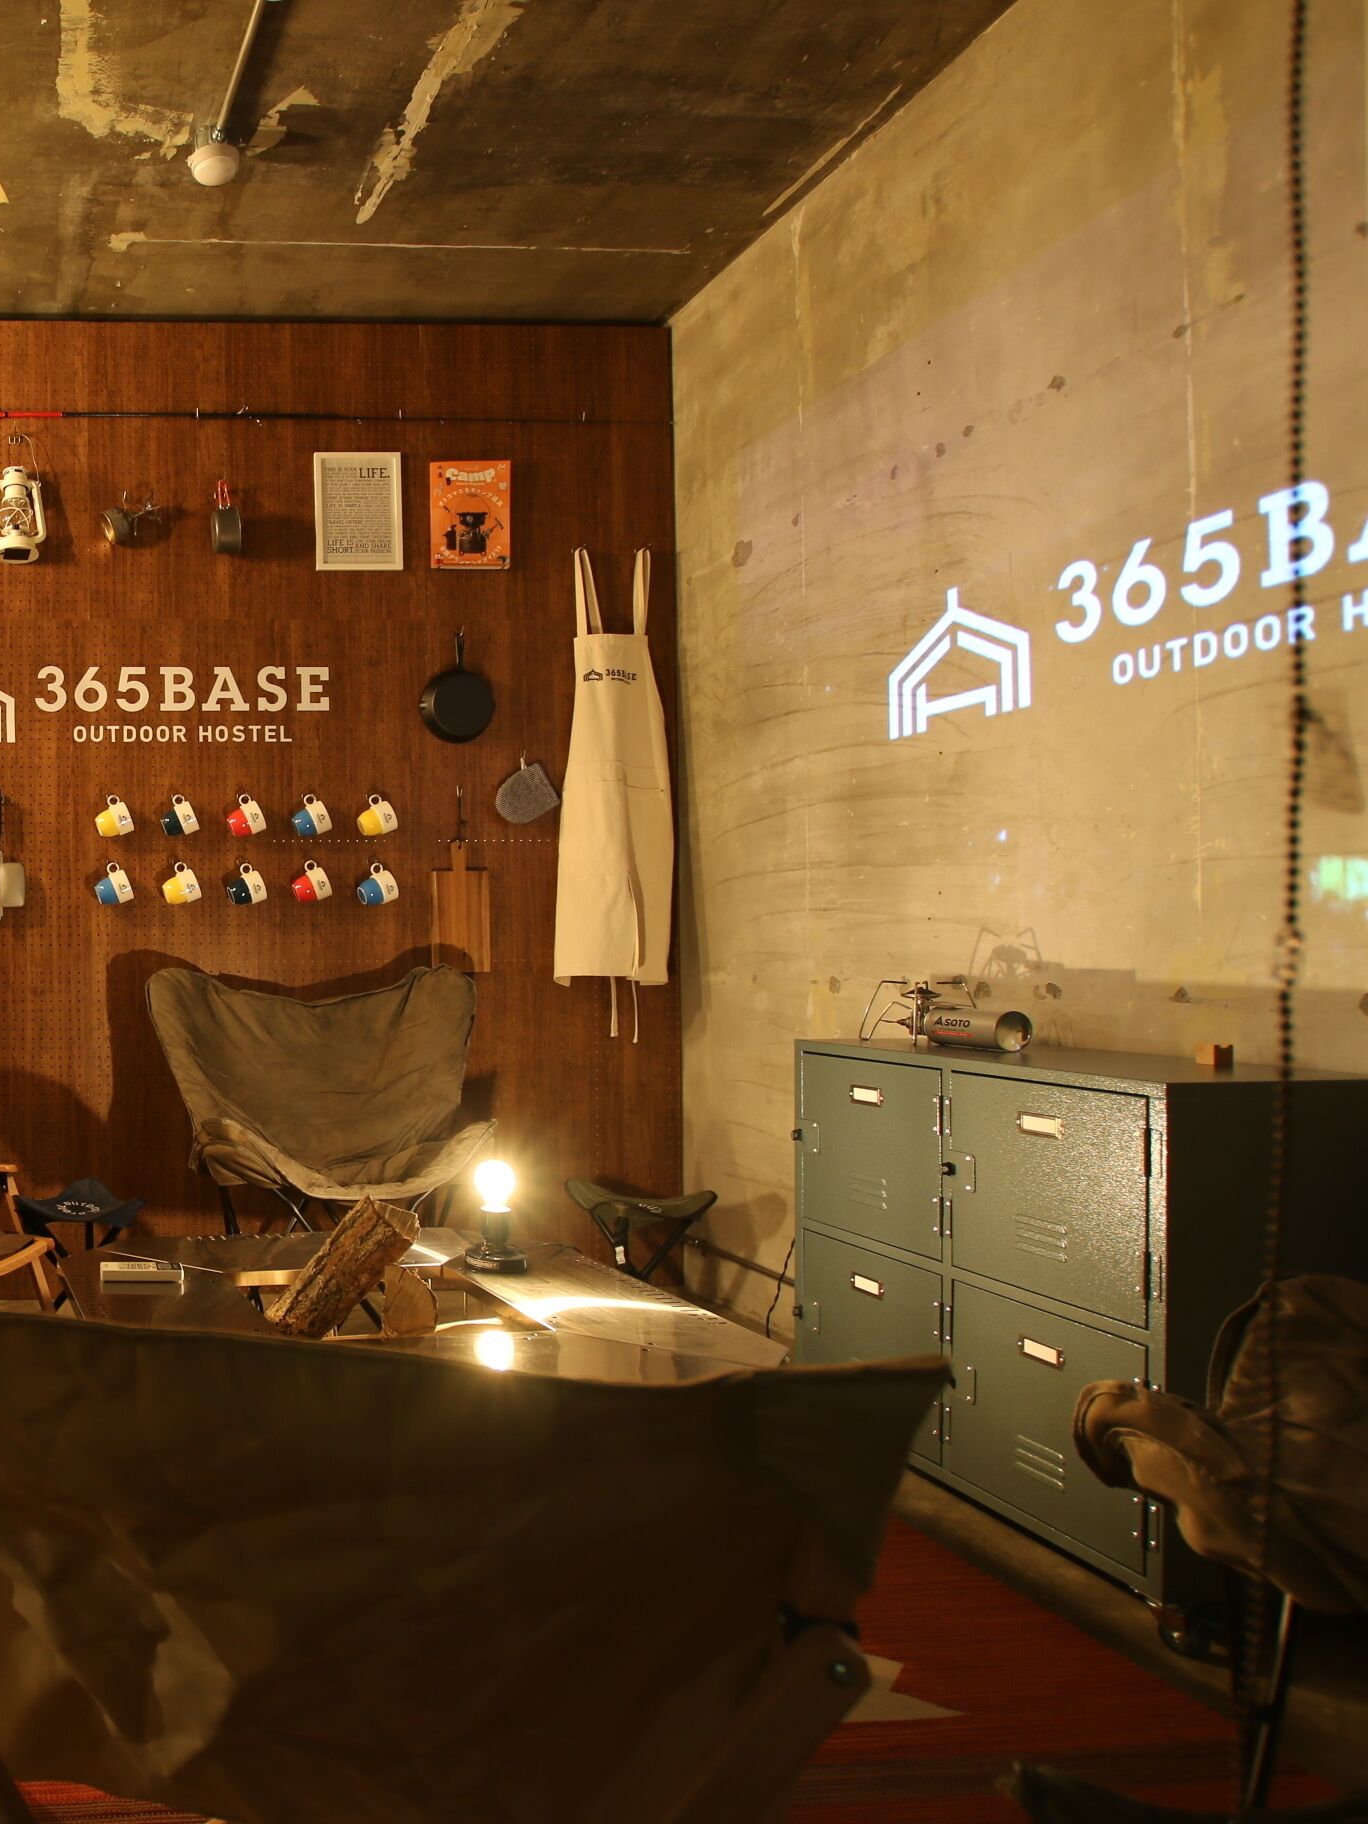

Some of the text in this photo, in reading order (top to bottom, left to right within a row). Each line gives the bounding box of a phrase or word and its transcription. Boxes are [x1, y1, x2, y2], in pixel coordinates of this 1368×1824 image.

[359, 467, 390, 479] LIFE.
[1112, 604, 1316, 685] OUTDOOR
[35, 666, 330, 712] 365BASE
[73, 725, 292, 743] OUTDOOR HOSTEL
[944, 1018, 970, 1028] SOTO
